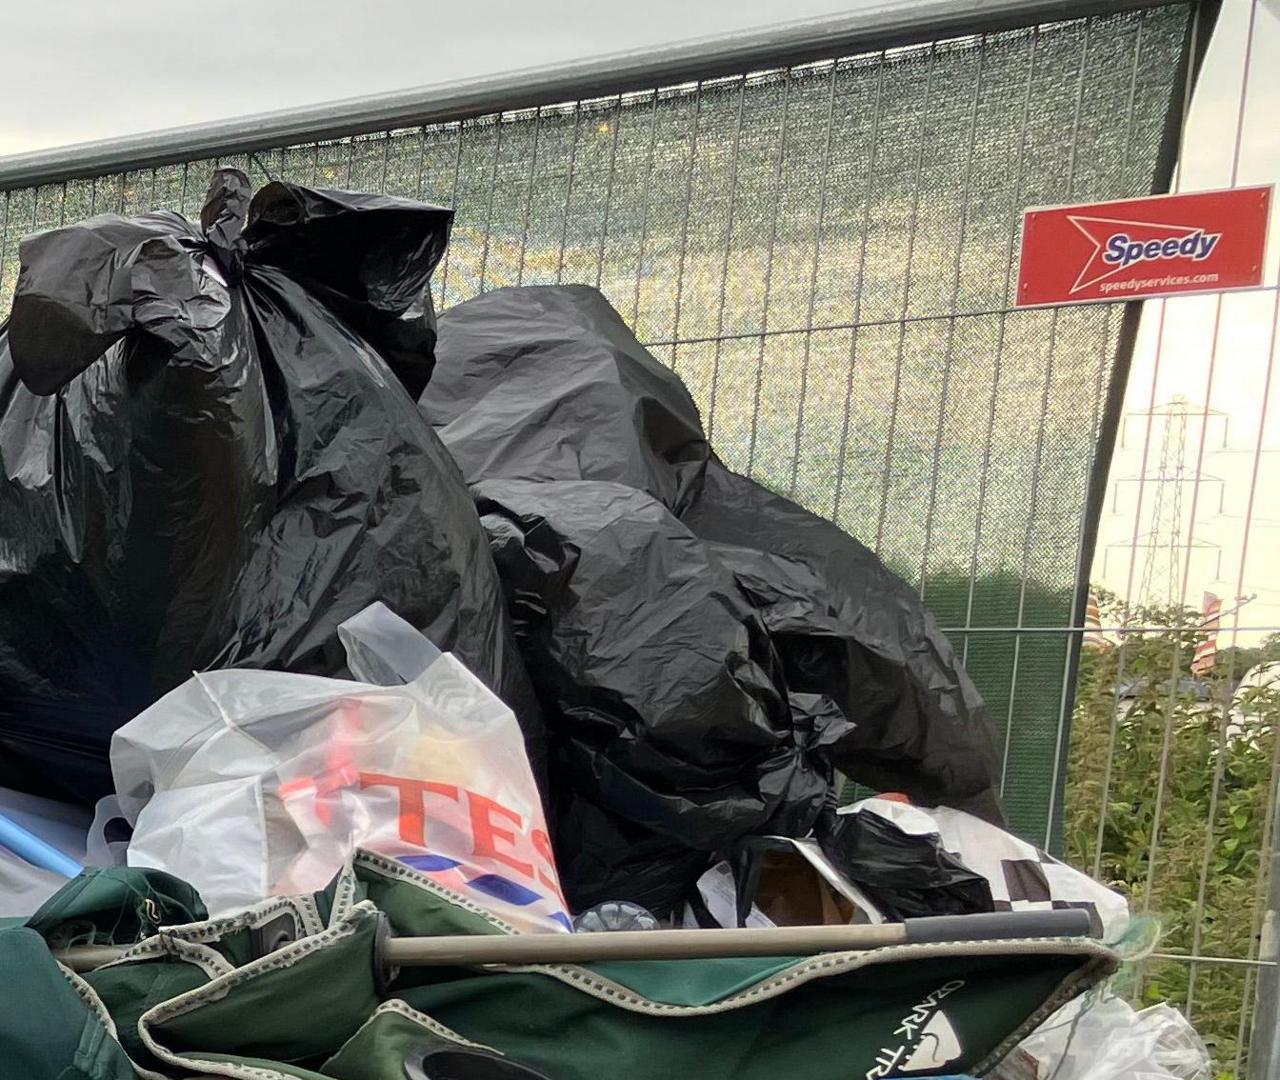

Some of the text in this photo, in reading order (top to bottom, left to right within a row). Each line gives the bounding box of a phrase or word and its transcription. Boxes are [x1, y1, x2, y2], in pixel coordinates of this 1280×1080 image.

[1103, 231, 1220, 266] Speedy
[1099, 272, 1219, 292] speedyservices.com
[893, 980, 965, 1040] OZARK
